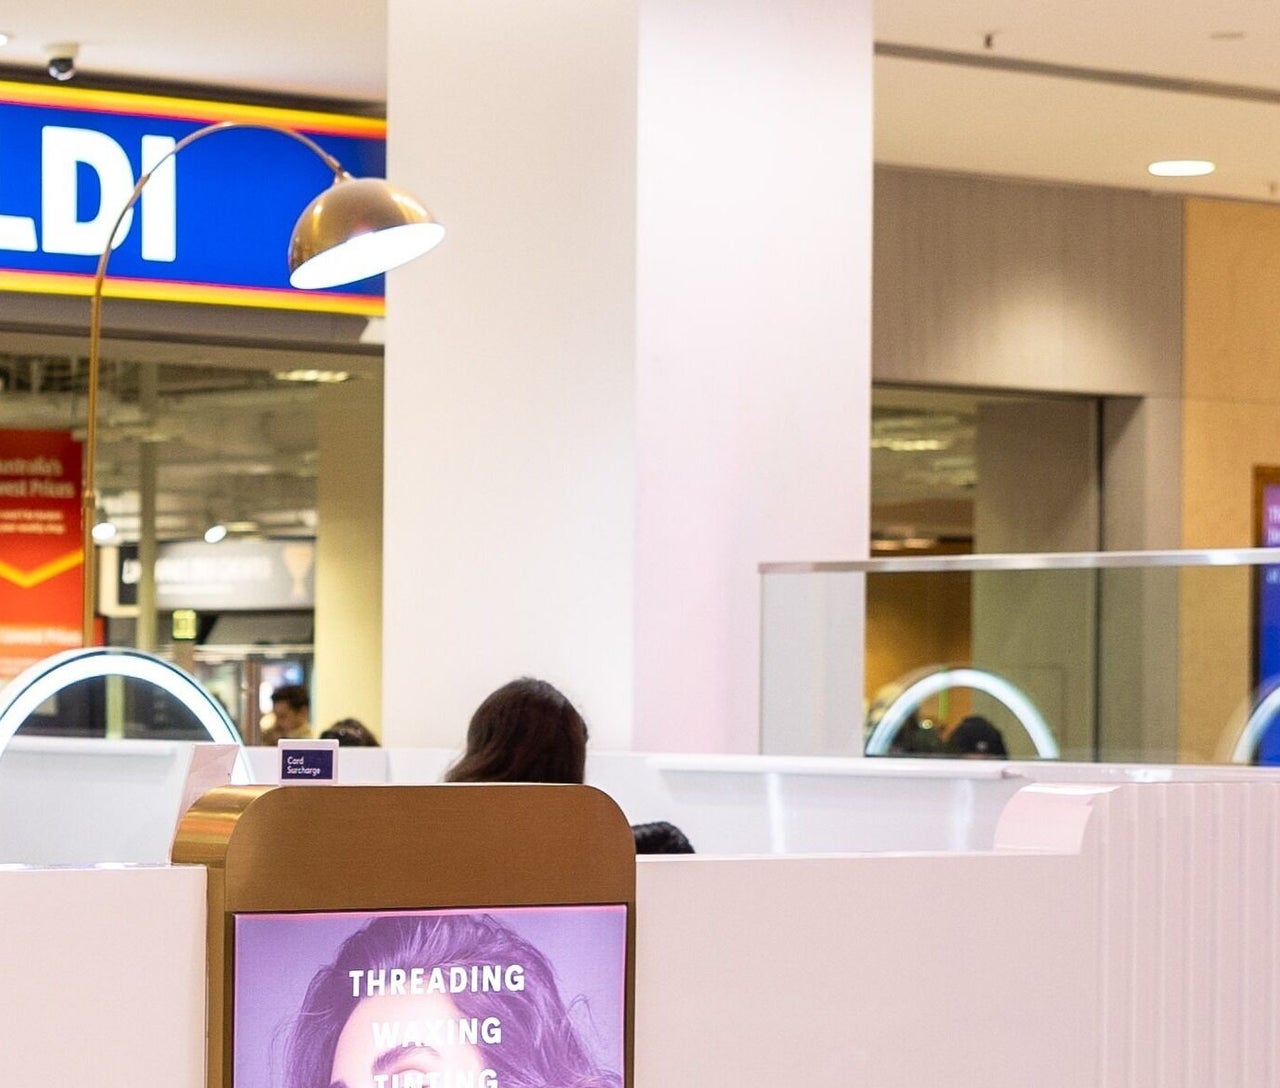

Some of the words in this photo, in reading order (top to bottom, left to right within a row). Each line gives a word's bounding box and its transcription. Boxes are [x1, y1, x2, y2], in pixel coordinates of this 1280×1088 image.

[287, 755, 304, 765] Card
[287, 765, 320, 777] Surcharge
[349, 964, 525, 997] THREADING
[372, 1017, 502, 1049] WAXING
